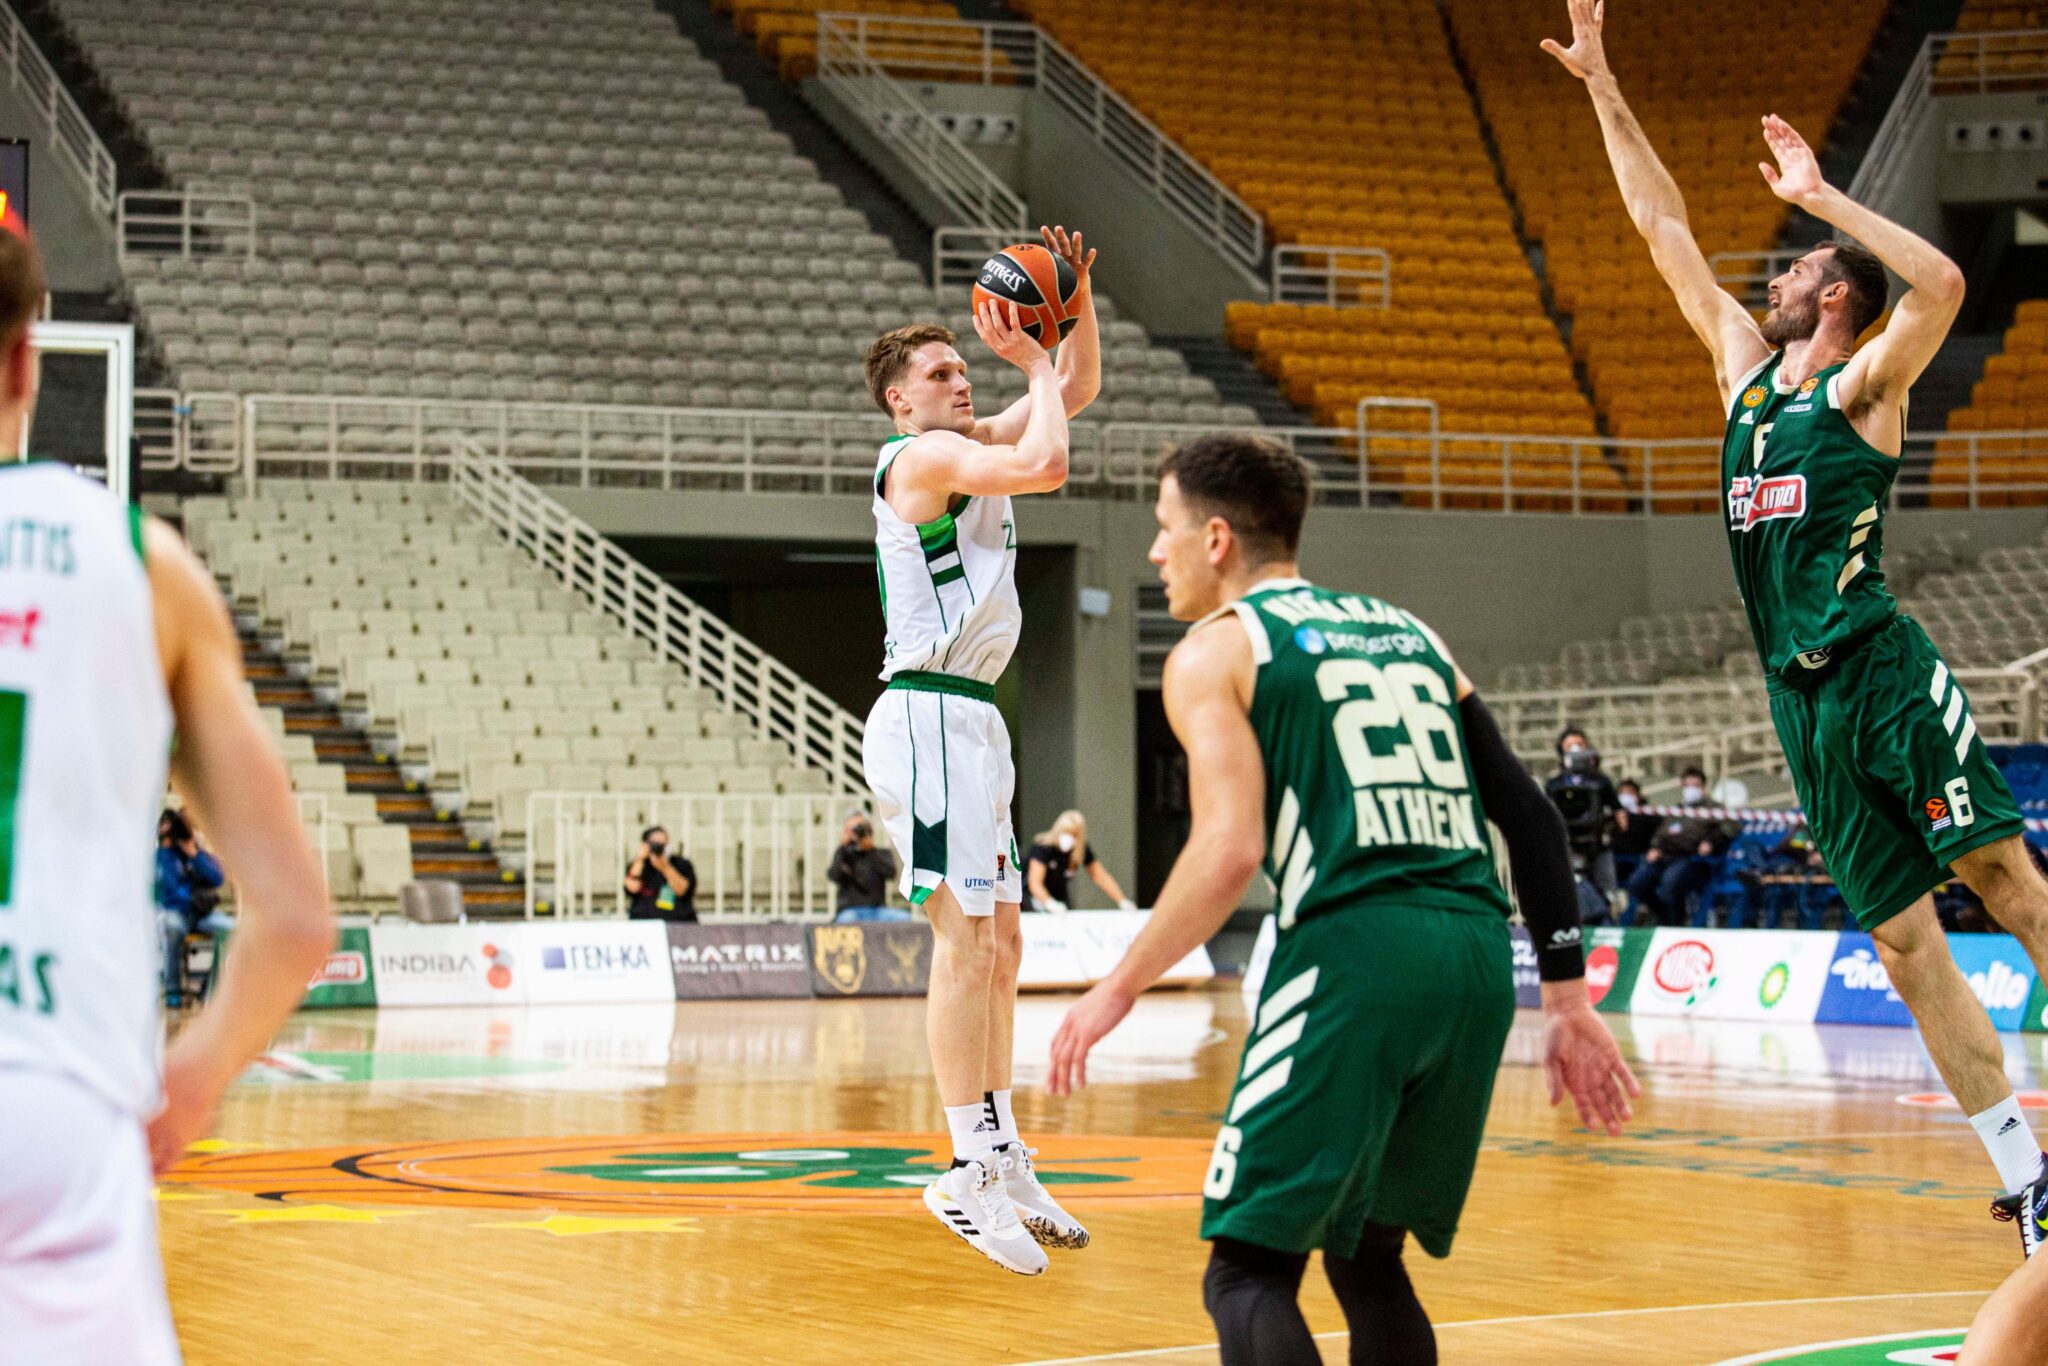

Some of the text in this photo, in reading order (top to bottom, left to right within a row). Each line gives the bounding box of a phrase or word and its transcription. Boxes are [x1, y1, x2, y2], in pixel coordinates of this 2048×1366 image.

[1315, 659, 1468, 788] 26
[1353, 788, 1488, 855] ATHEN
[1944, 776, 1975, 828] 6
[965, 878, 994, 889] UTENOS
[671, 944, 804, 963] MATRIX
